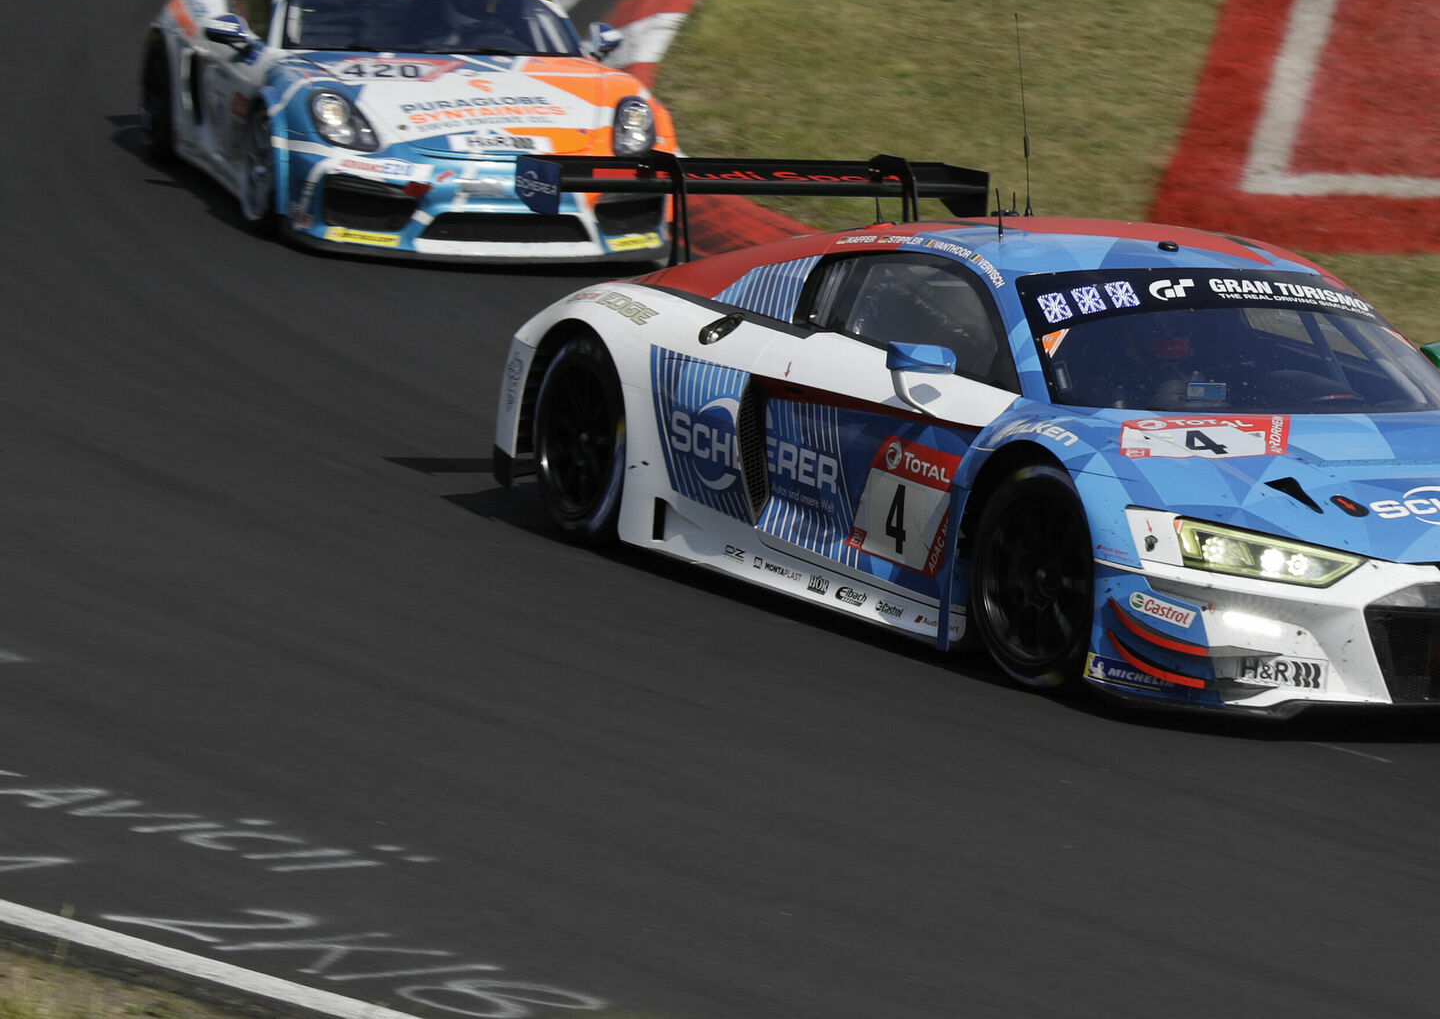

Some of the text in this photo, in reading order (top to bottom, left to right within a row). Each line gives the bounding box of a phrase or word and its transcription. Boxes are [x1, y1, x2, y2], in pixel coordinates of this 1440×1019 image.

[342, 63, 419, 79] 420
[400, 96, 552, 113] PURAGLOBE
[407, 105, 567, 125] SYNTAINICS
[515, 175, 557, 196] SCHERER
[887, 236, 923, 246] STIPPLER
[933, 240, 972, 259] VANTHOOR
[977, 258, 1006, 289] VERVISCH
[1208, 278, 1371, 312] GRAN TURISMO
[595, 291, 660, 326] EDGE
[1243, 293, 1273, 301] REAL
[1273, 295, 1318, 305] DRIVING
[1318, 300, 1377, 319] SIMULATOR
[1167, 419, 1254, 428] TOTAL
[671, 410, 839, 494] SCHERER
[1185, 429, 1228, 455] 4
[903, 451, 950, 483] TOTAL
[885, 483, 906, 555] 4
[724, 544, 746, 559] OZ
[764, 562, 803, 582] MONTAPLAST
[836, 586, 869, 603] Eibach
[880, 602, 905, 618] Castrol
[1143, 599, 1191, 626] Castrol
[1107, 666, 1177, 688] MICHELIN
[1241, 659, 1291, 683] H&R
